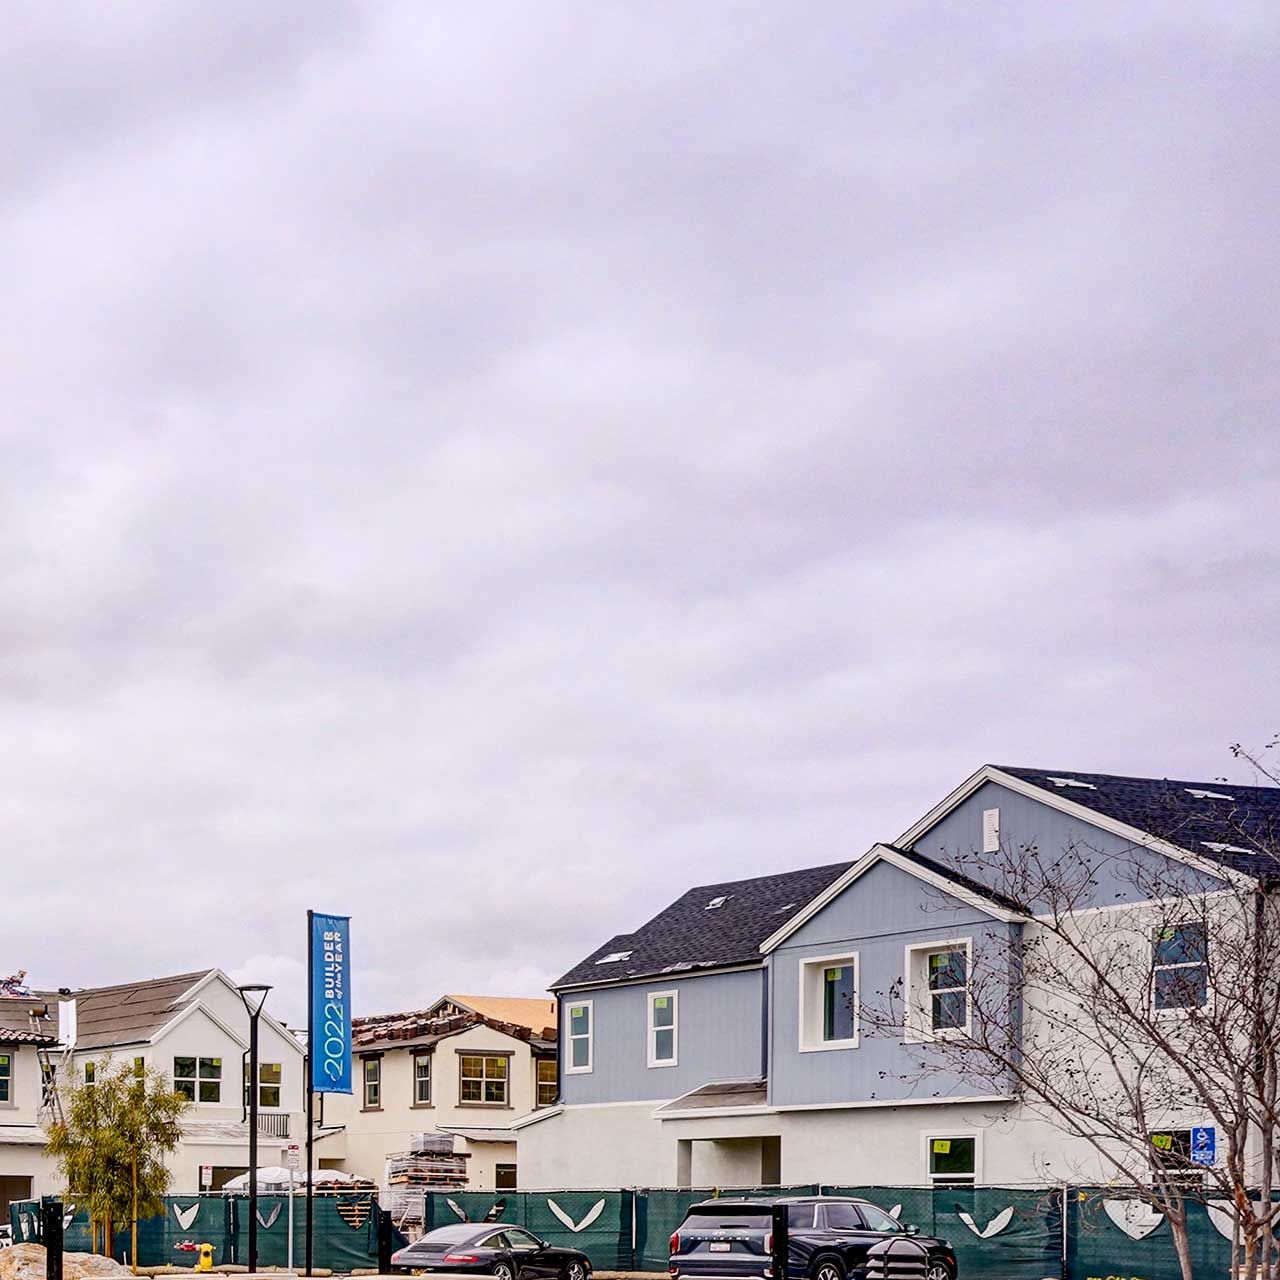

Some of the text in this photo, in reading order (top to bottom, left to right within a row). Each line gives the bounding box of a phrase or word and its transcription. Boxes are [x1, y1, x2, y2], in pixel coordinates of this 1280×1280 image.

[324, 931, 335, 999] BUILDER
[335, 932, 343, 972] YEAR
[324, 1001, 344, 1082] 2022
